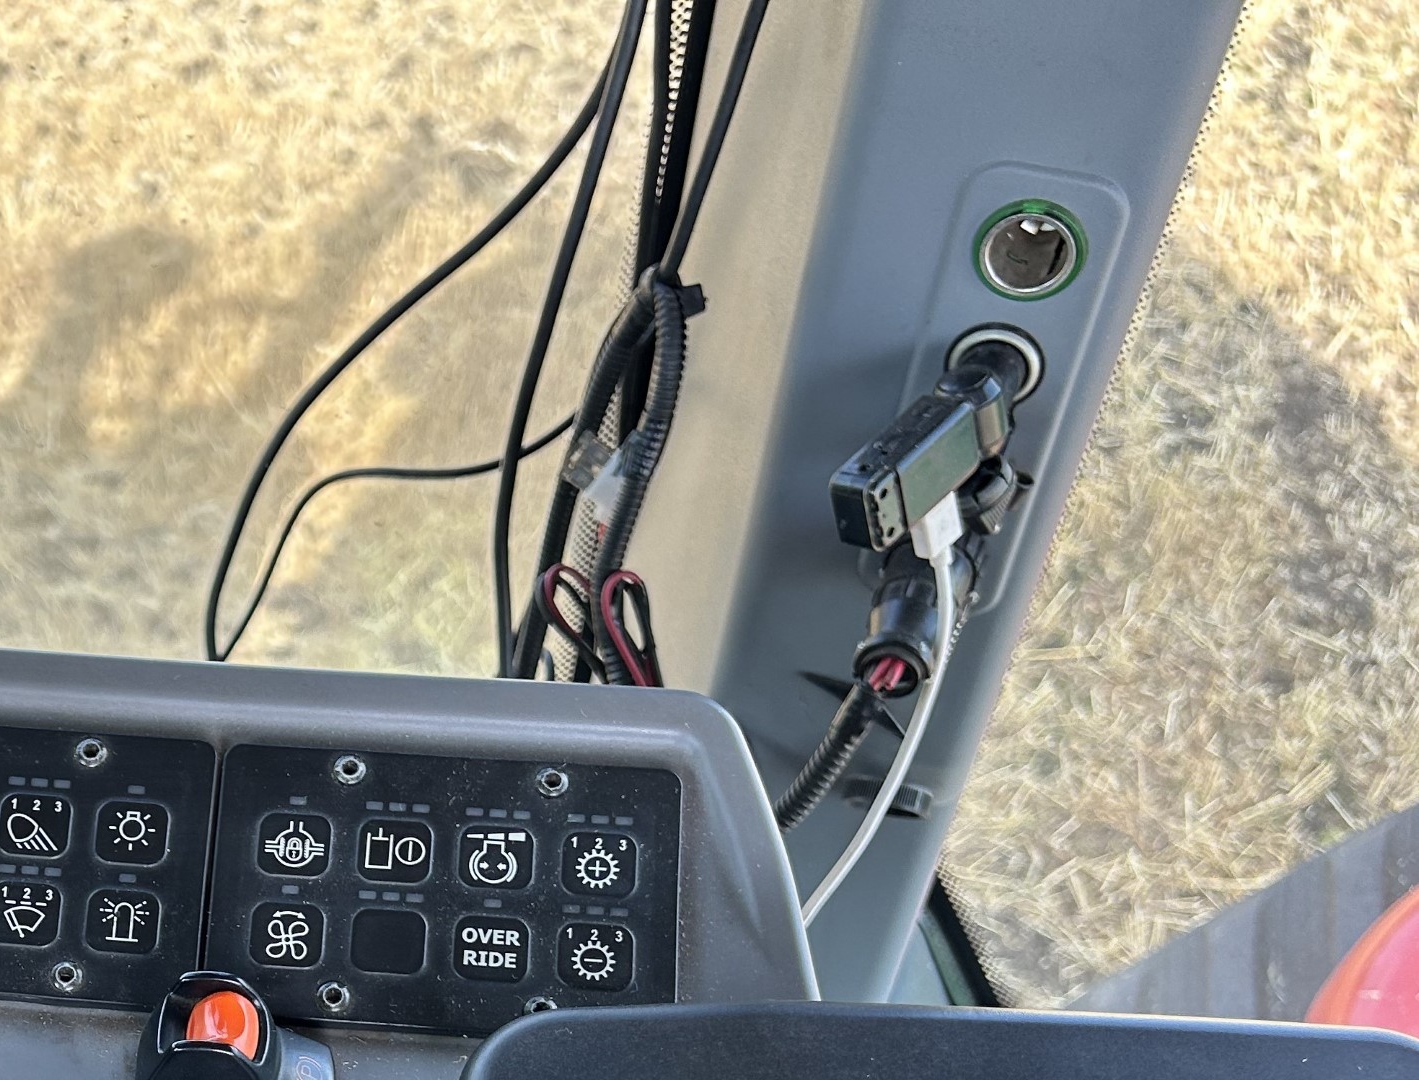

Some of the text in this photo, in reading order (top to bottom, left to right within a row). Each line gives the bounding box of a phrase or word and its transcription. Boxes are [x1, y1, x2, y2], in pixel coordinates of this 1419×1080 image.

[12, 798, 61, 812] 1 2 3
[571, 837, 626, 850] 1 2 3
[2, 886, 53, 900] 1 2 3
[462, 928, 520, 946] OVER
[567, 928, 622, 942] 1 2 3
[463, 950, 516, 968] RIDE
[301, 1065, 317, 1080] P
